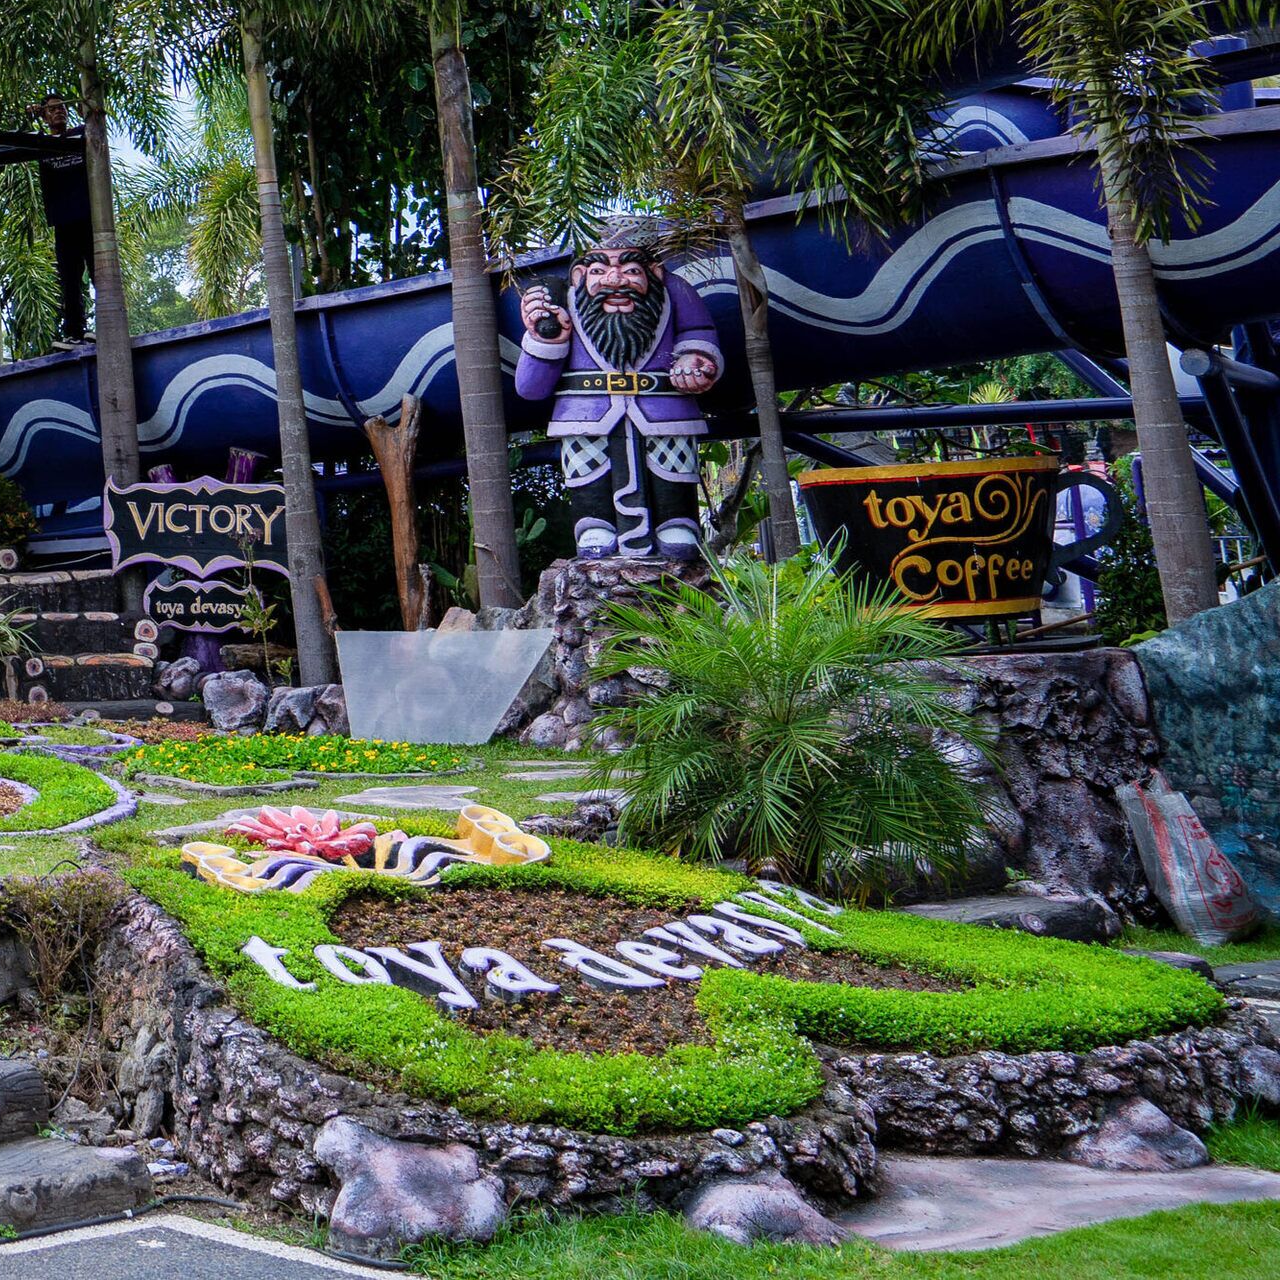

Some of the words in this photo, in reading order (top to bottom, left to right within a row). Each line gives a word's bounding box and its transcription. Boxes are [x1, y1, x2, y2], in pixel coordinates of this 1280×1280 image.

[126, 501, 286, 545] VICTORY
[863, 489, 973, 542] toya
[890, 553, 1033, 601] Coffee
[155, 599, 185, 619] toya
[190, 596, 251, 619] devasy
[241, 933, 561, 1010] toya
